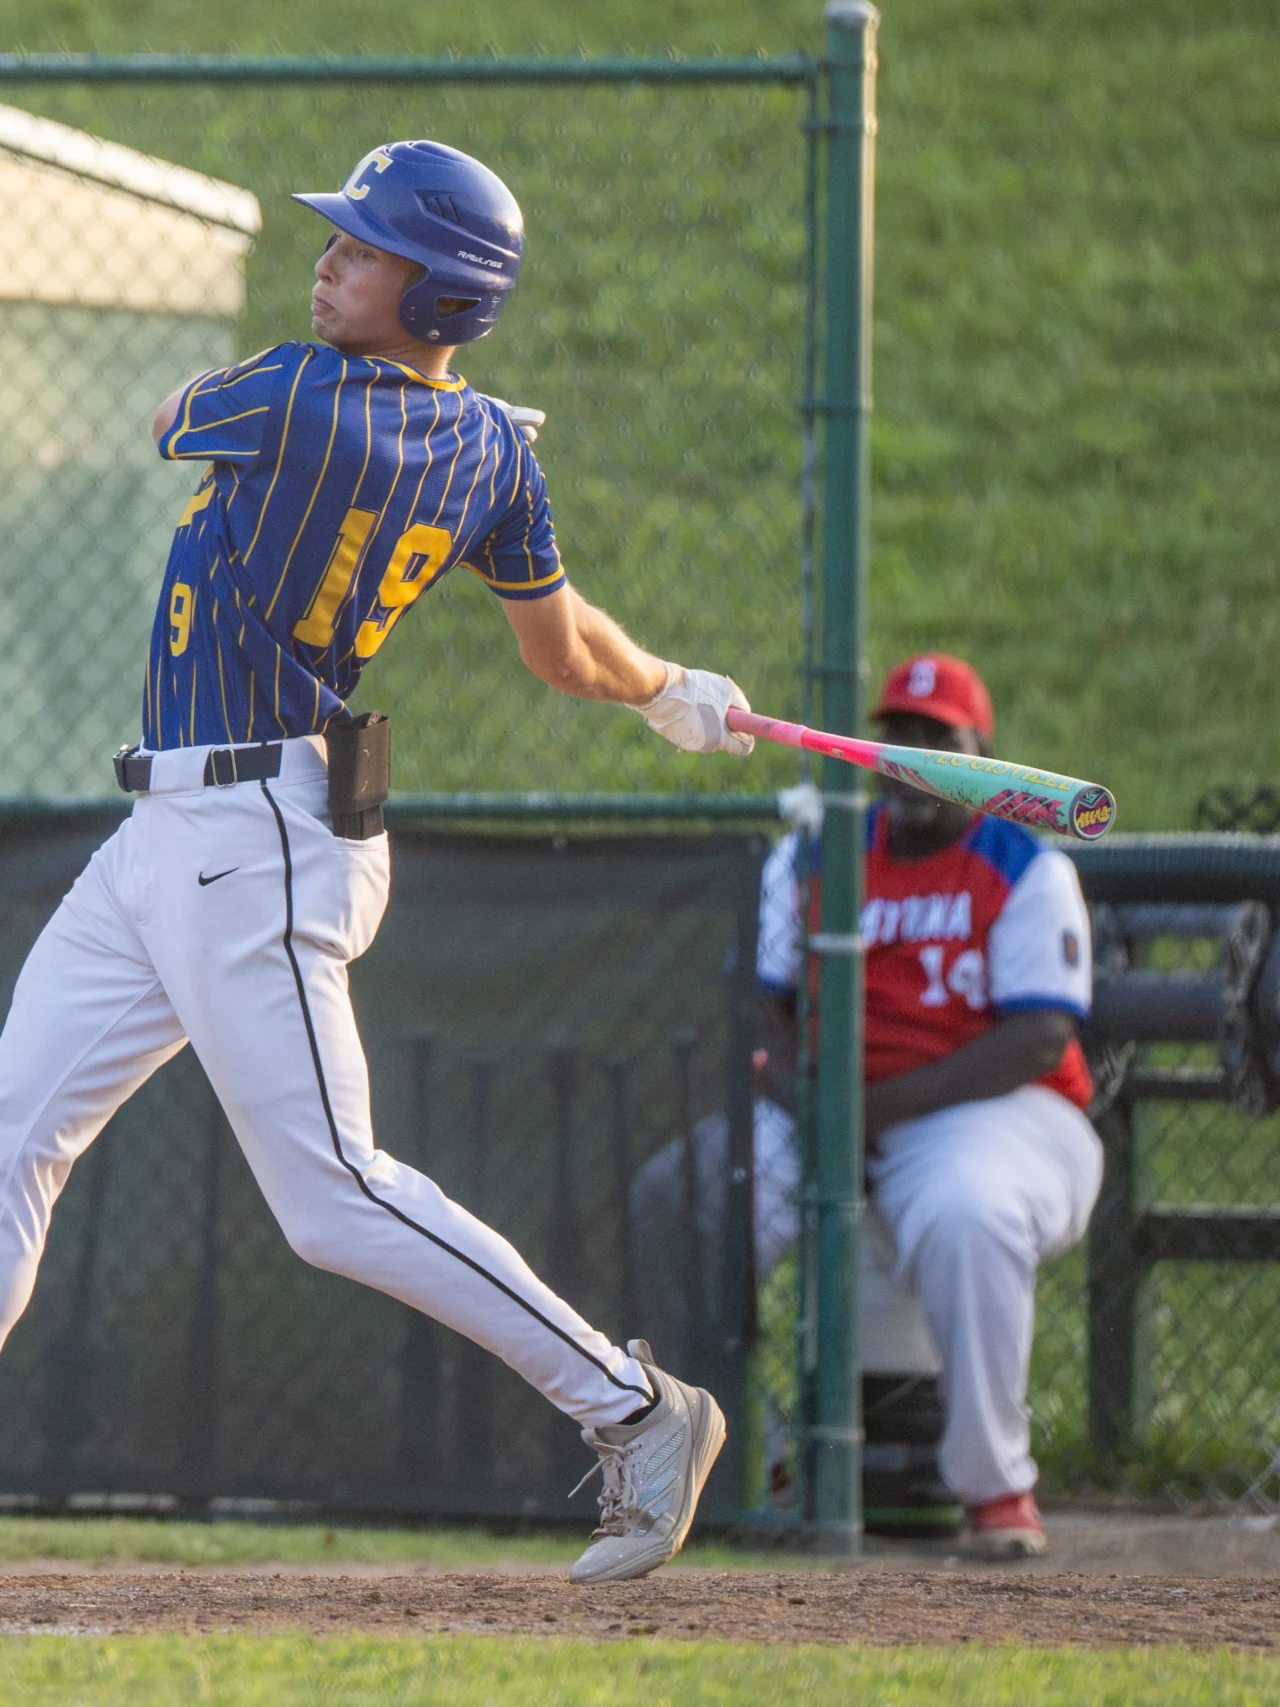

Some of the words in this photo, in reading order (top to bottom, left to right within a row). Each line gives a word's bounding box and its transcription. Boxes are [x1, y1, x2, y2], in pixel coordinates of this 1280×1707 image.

[345, 152, 394, 201] C
[457, 250, 504, 269] RAWLINGS
[292, 505, 454, 659] 19
[170, 582, 192, 657] 9
